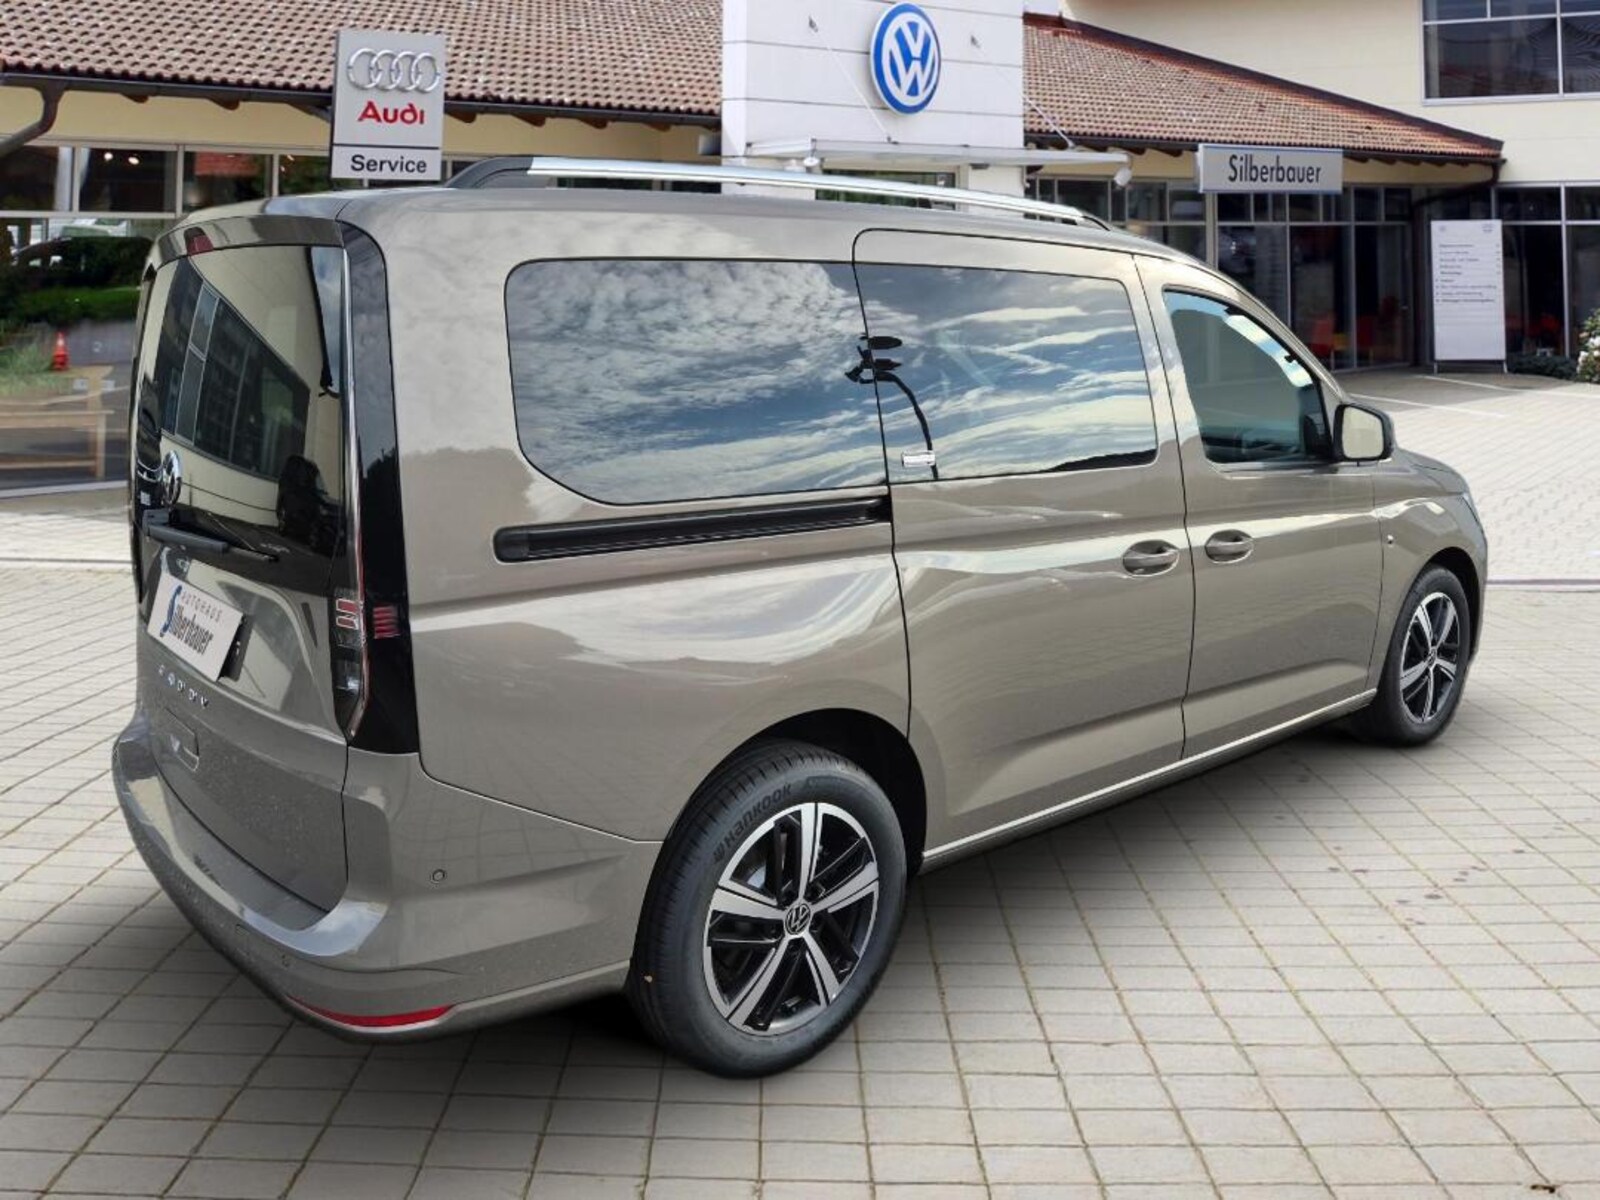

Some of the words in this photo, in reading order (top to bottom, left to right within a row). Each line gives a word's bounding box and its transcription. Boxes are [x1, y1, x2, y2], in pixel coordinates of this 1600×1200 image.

[357, 100, 424, 125] Audi
[350, 154, 427, 173] Service
[1228, 154, 1321, 183] Silberbauer
